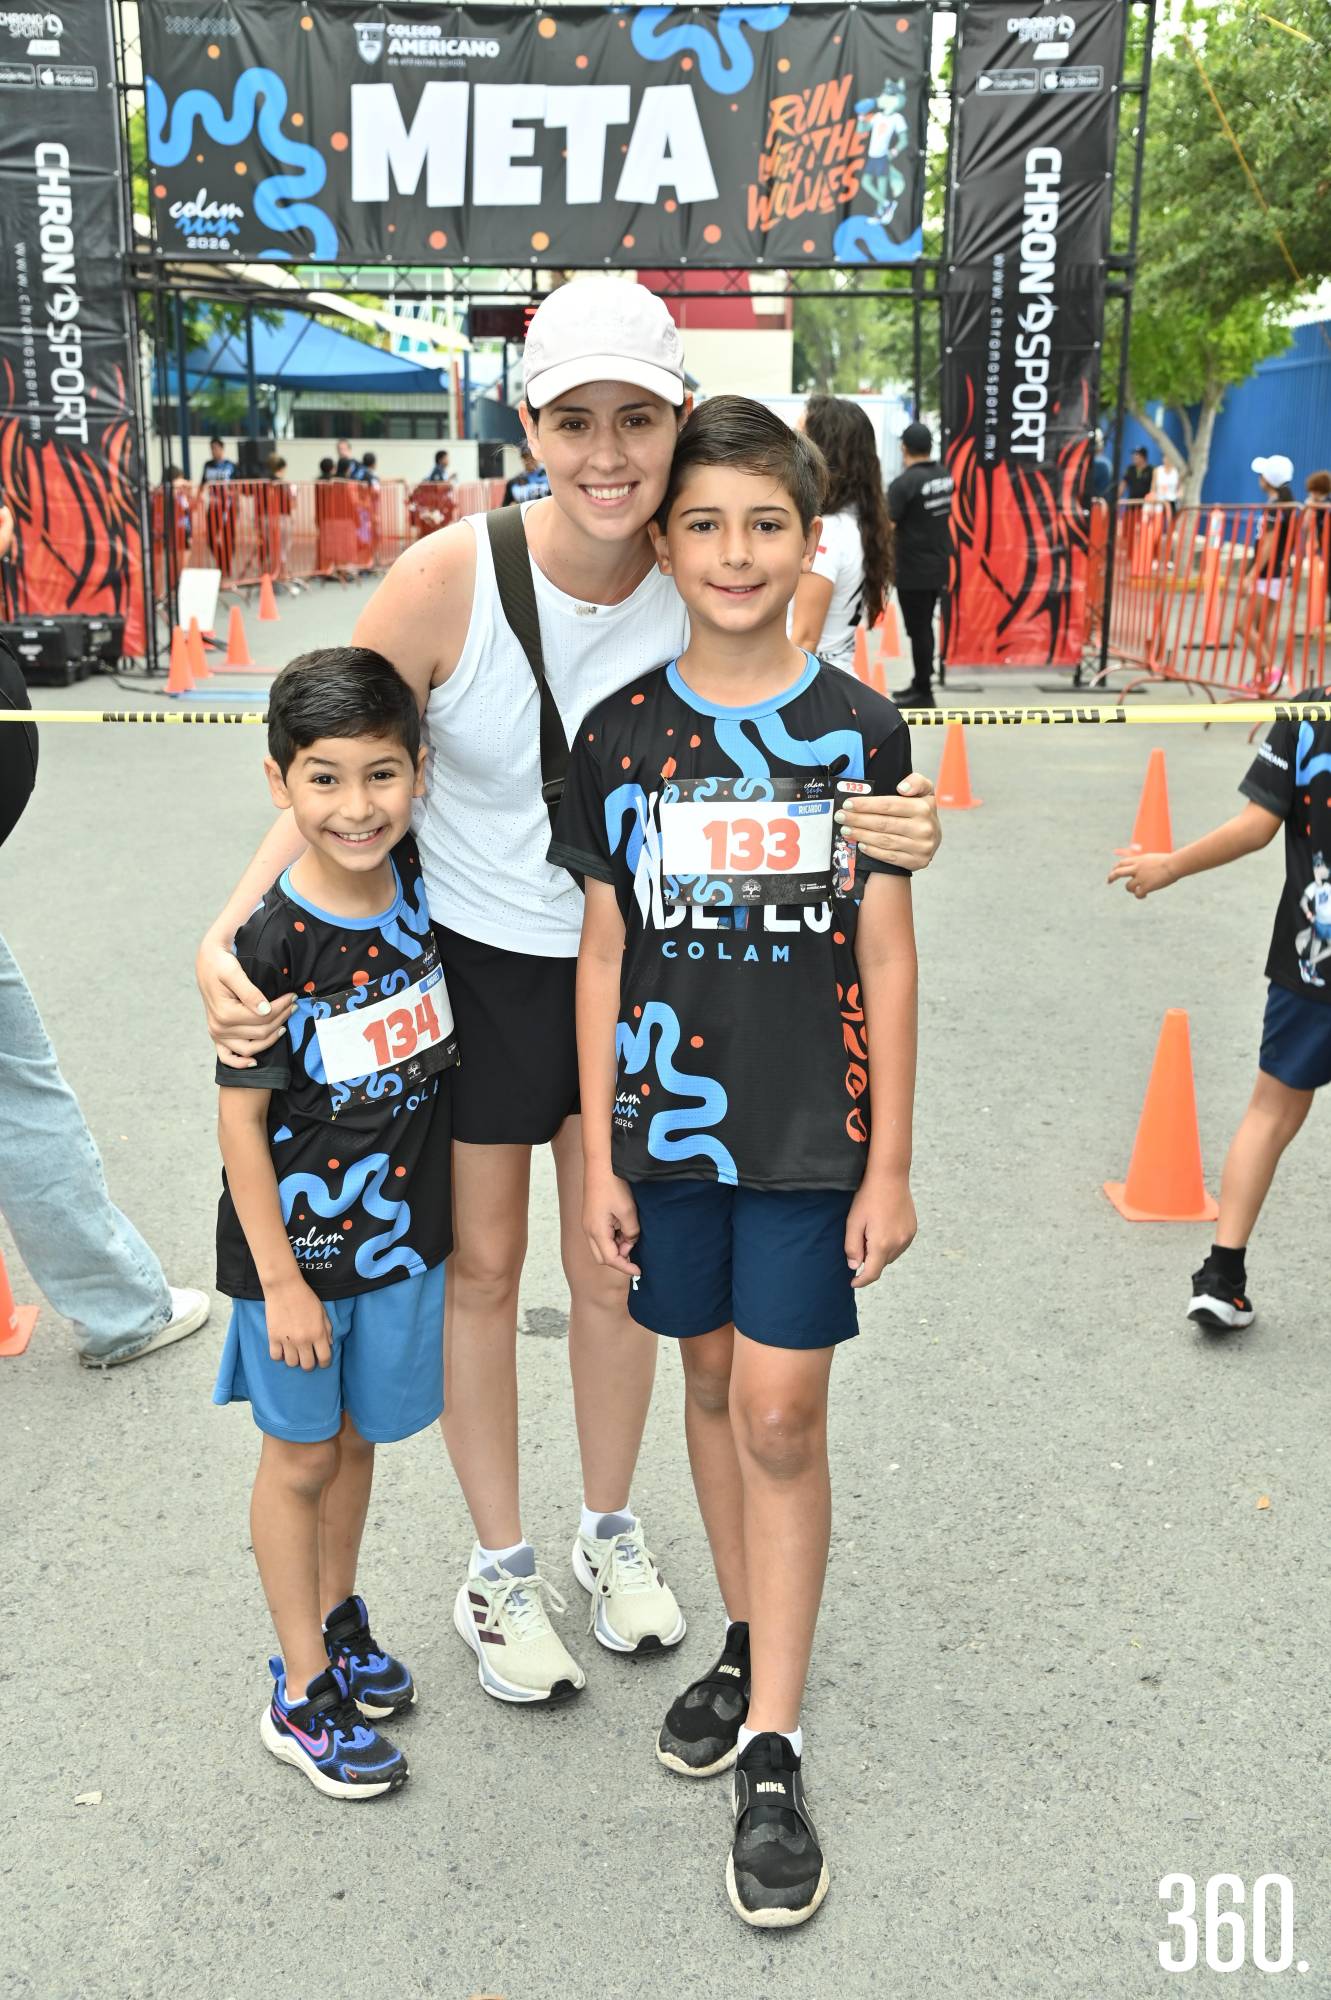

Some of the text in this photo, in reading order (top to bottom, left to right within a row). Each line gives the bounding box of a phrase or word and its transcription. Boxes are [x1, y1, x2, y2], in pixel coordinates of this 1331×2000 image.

[386, 23, 442, 38] COLEGIO
[387, 38, 500, 58] AMERICANO
[765, 74, 853, 149] RUN
[351, 81, 719, 207] META
[747, 158, 865, 232] WOLVES
[187, 237, 230, 250] 2026
[983, 253, 1005, 461] www.chronosport.mx
[845, 783, 864, 792] 133
[798, 804, 822, 815] RICARDO
[702, 818, 801, 872] 133
[661, 940, 790, 963] COLAM
[362, 993, 441, 1067] 134
[718, 1663, 742, 1679] NIKE
[756, 1781, 786, 1795] NIKE
